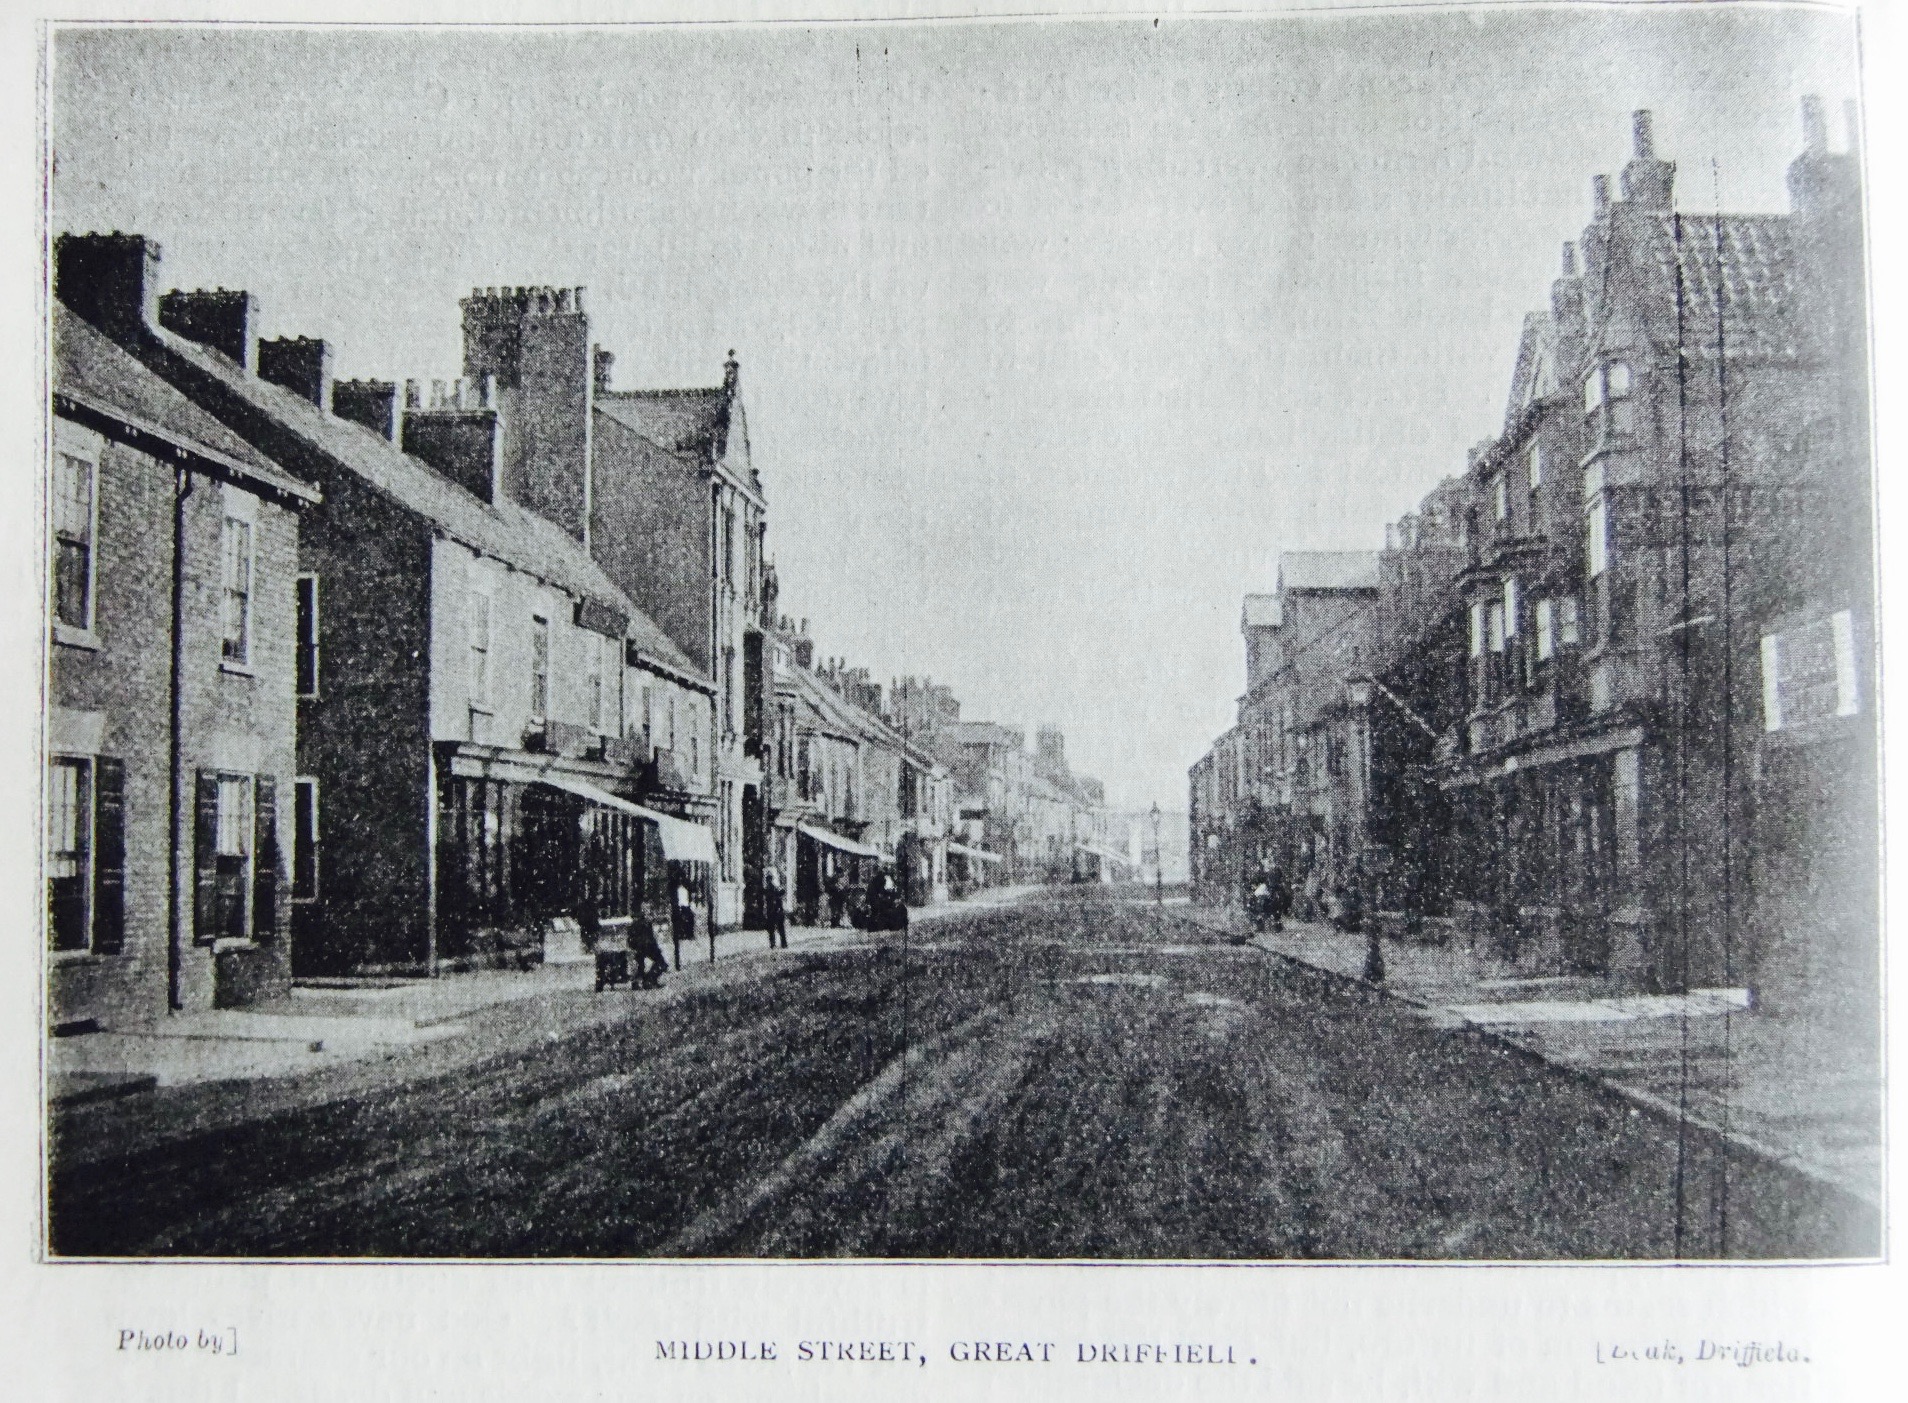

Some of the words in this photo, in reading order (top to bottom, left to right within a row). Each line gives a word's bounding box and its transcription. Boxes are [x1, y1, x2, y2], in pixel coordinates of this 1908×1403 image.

[117, 1329, 188, 1351] Photo
[655, 1340, 777, 1361] MIDDLE
[797, 1340, 926, 1368] STREET,
[950, 1342, 1055, 1362] GREAT
